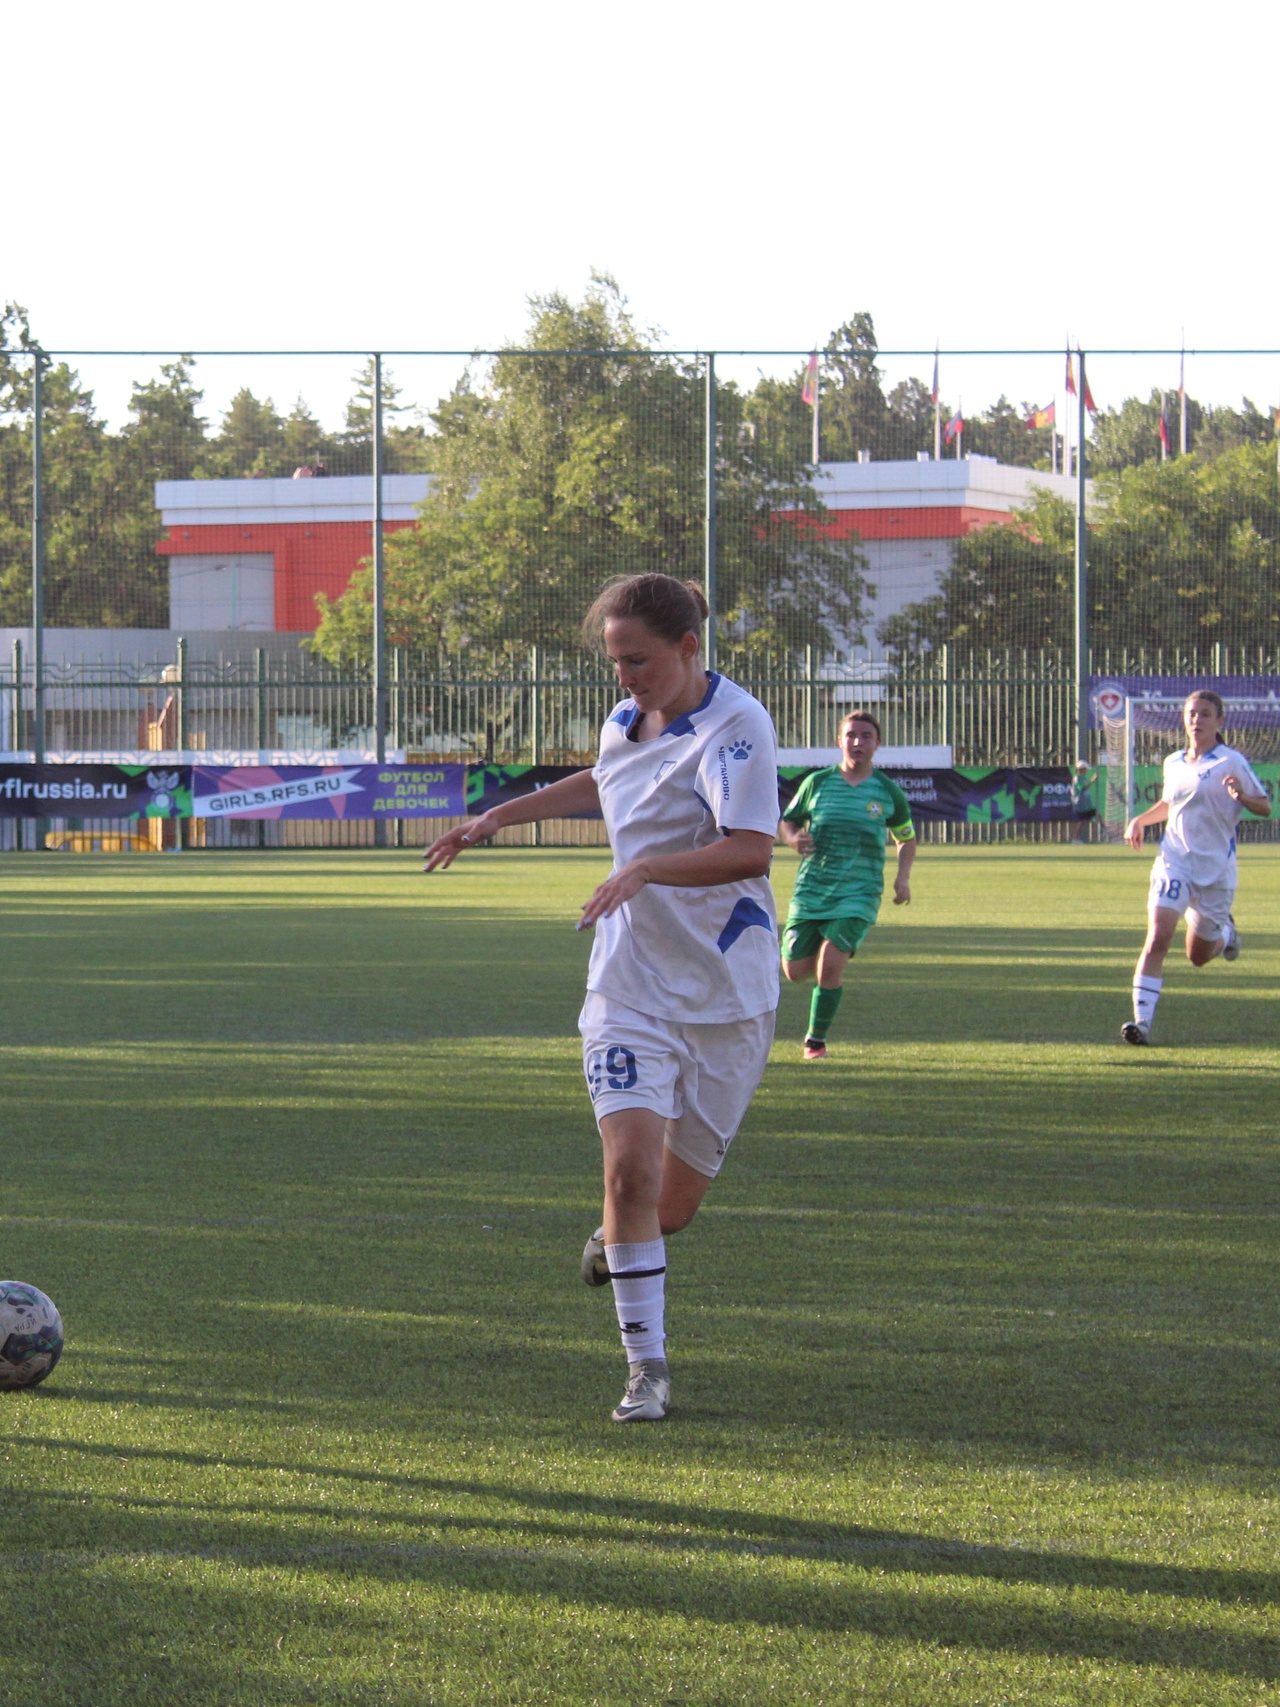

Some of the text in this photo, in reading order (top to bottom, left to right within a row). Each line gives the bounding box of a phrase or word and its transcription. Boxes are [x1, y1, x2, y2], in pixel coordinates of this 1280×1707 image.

[378, 771, 445, 783] ФУТБОЛ
[718, 745, 730, 801] ЧЕРТАНОВО
[209, 777, 341, 812] GIRLS.RFS.RU
[394, 784, 428, 797] ДЛЯ
[372, 797, 449, 812] ДЕВОЧЕК
